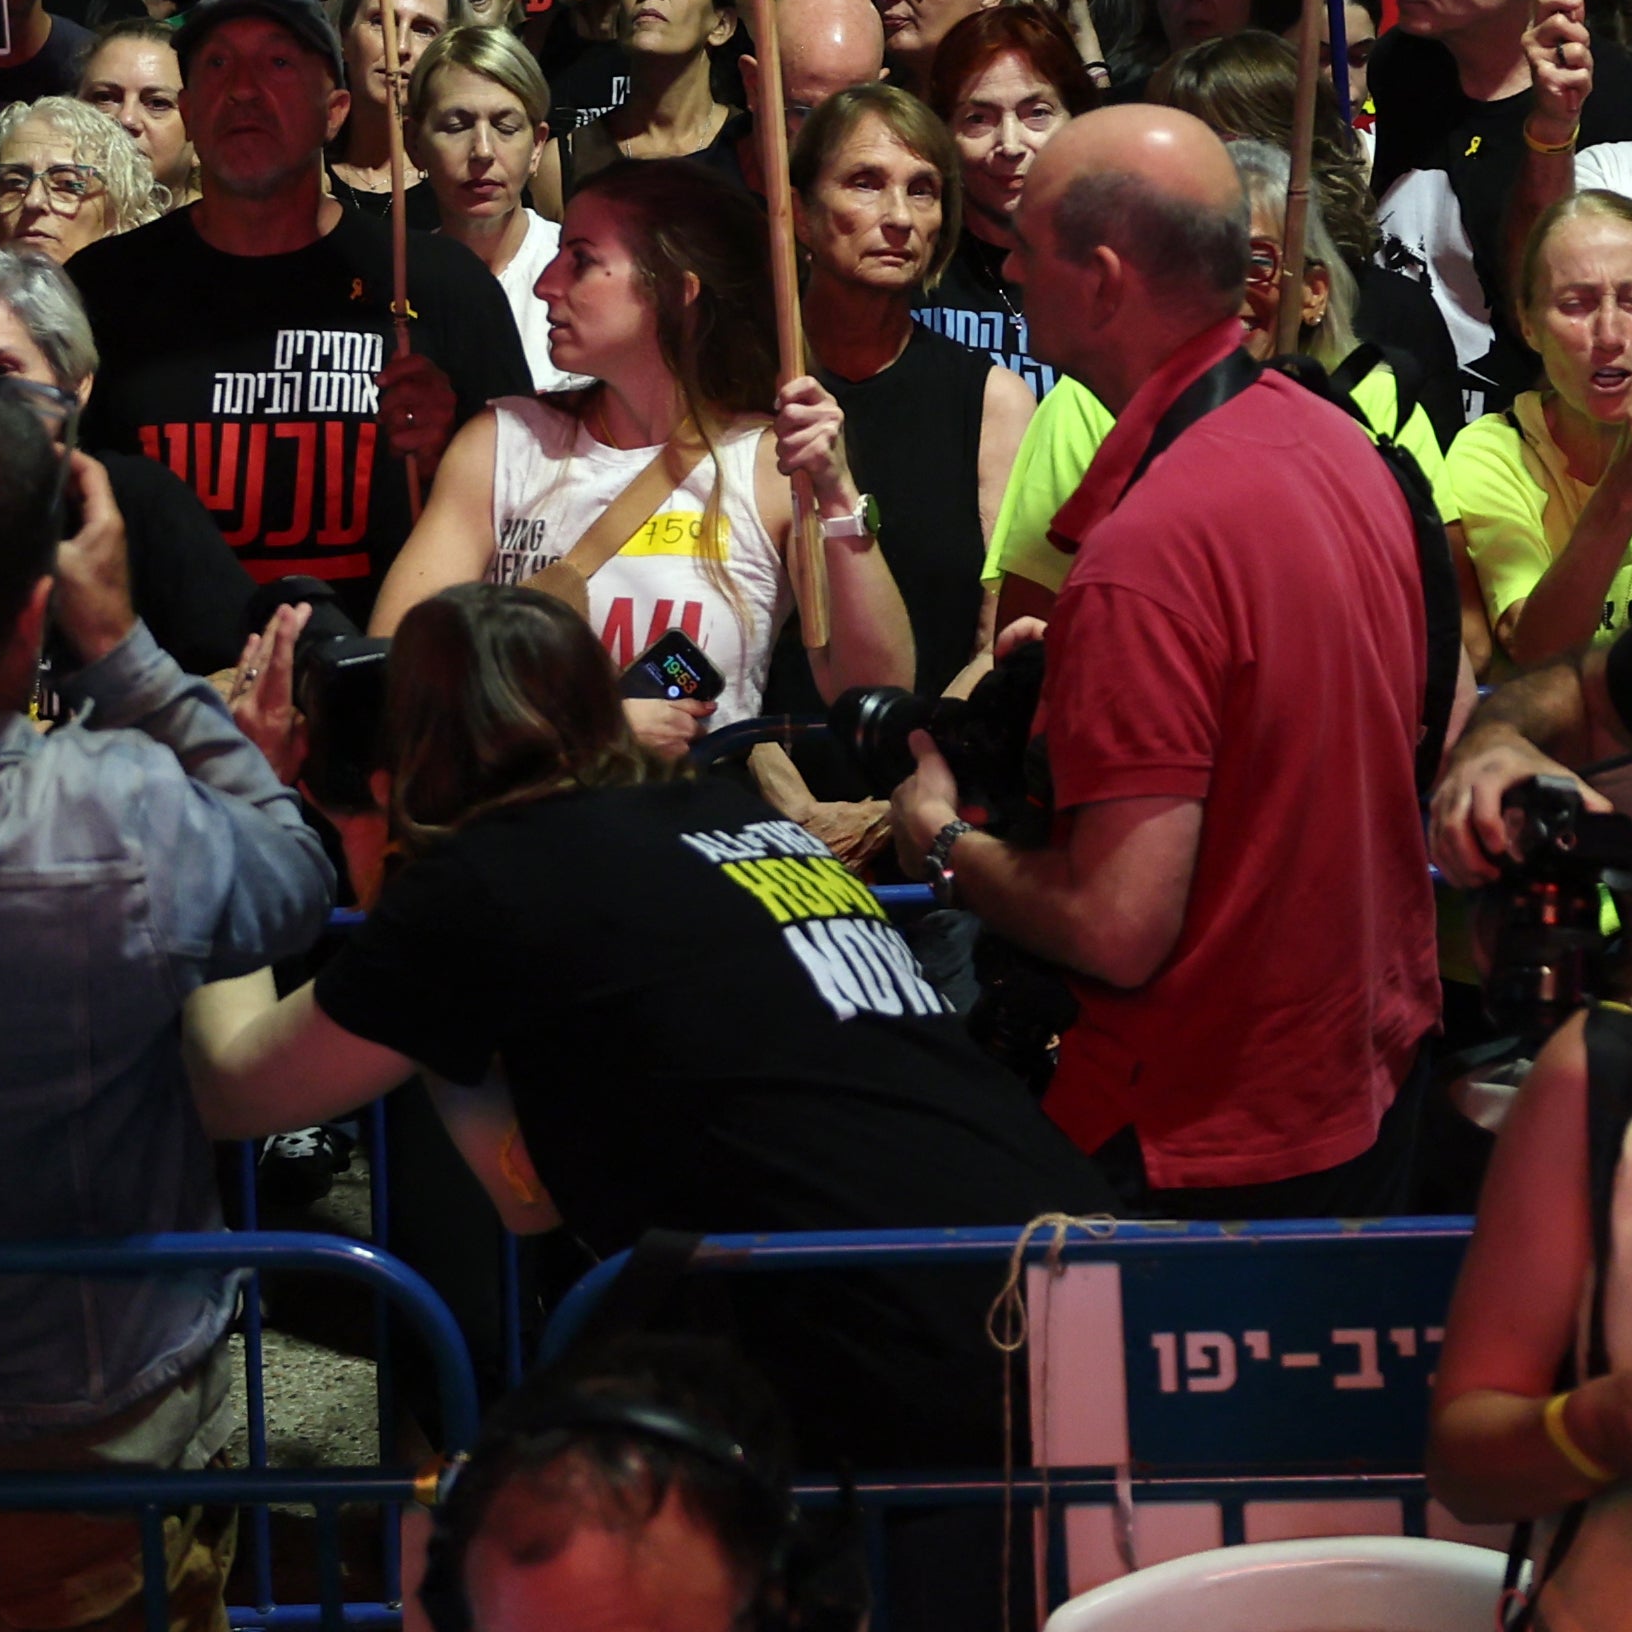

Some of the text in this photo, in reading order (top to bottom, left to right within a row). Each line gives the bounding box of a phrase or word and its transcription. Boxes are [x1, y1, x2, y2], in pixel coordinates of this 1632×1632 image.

[275, 329, 383, 372] מחזירים
[213, 371, 379, 414] אותם הביתה
[664, 655, 698, 694] 19:53
